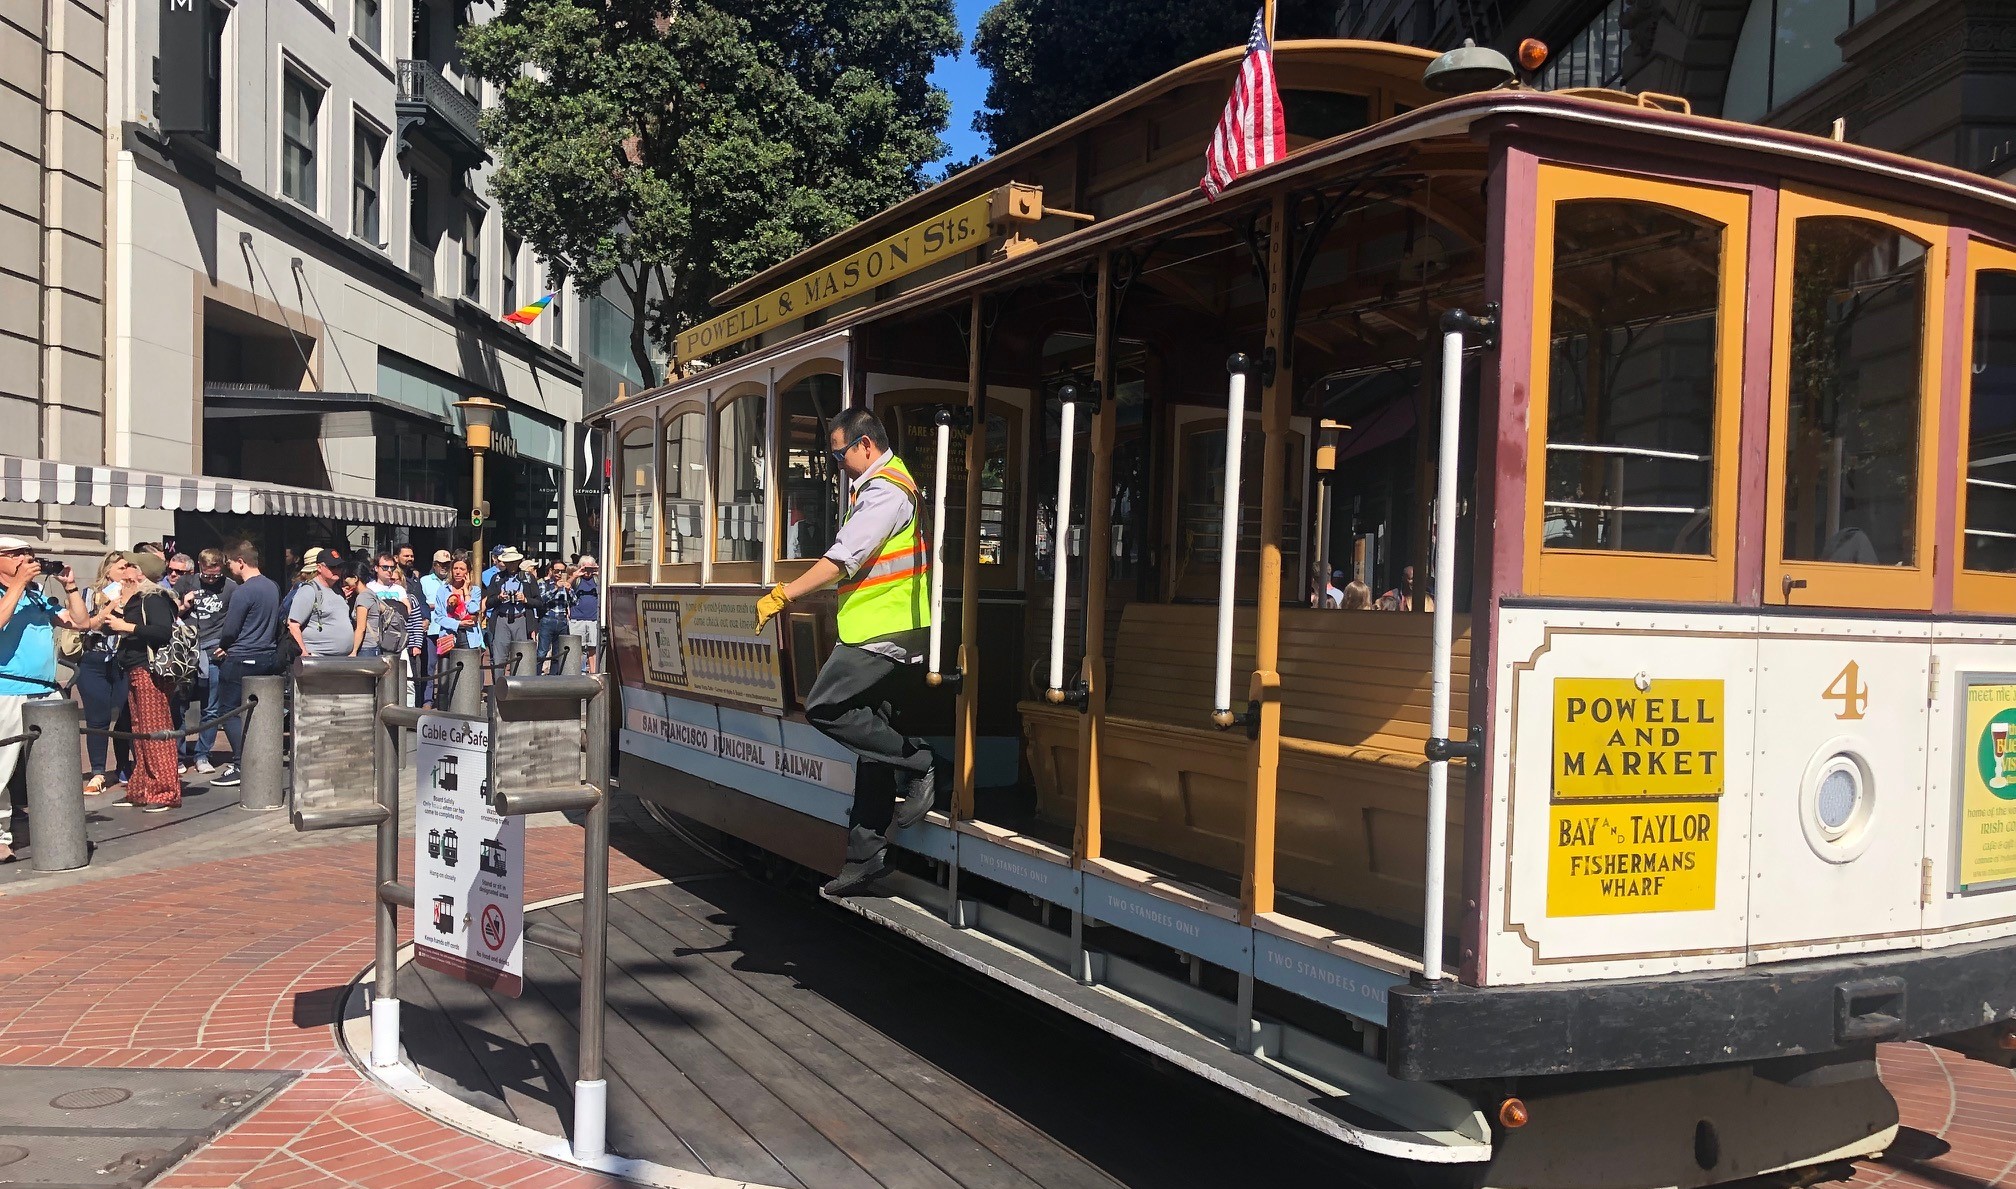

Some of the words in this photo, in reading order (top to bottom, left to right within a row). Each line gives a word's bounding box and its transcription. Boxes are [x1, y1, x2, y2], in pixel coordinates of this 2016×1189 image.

[687, 304, 769, 353] POWELL
[778, 292, 794, 316] &
[804, 237, 910, 305] MASON
[923, 217, 976, 255] Sts.
[1821, 659, 1868, 720] 4
[1566, 698, 1714, 724] POWELL
[422, 724, 447, 741] Cable
[450, 728, 466, 744] Car
[468, 730, 488, 747] Safe
[642, 715, 658, 734] SAN
[660, 720, 708, 748] FRANCISCO
[1606, 728, 1680, 747] AND
[1564, 751, 1718, 776] MARKET
[1558, 817, 1600, 847] BAY
[1630, 813, 1710, 844] TAYLOR
[980, 854, 994, 866] TWO
[996, 858, 1028, 878] STANDEES
[1030, 870, 1048, 884] ONLY
[1570, 852, 1696, 876] FISHERMANS
[1600, 876, 1666, 898] WHARF
[1108, 896, 1127, 910] TWO
[1130, 903, 1172, 927] STANDEES
[1176, 920, 1200, 938] ONLY
[1268, 950, 1293, 969] TWO
[1297, 961, 1355, 992] STANDEES
[1361, 984, 1388, 1004] ONL
